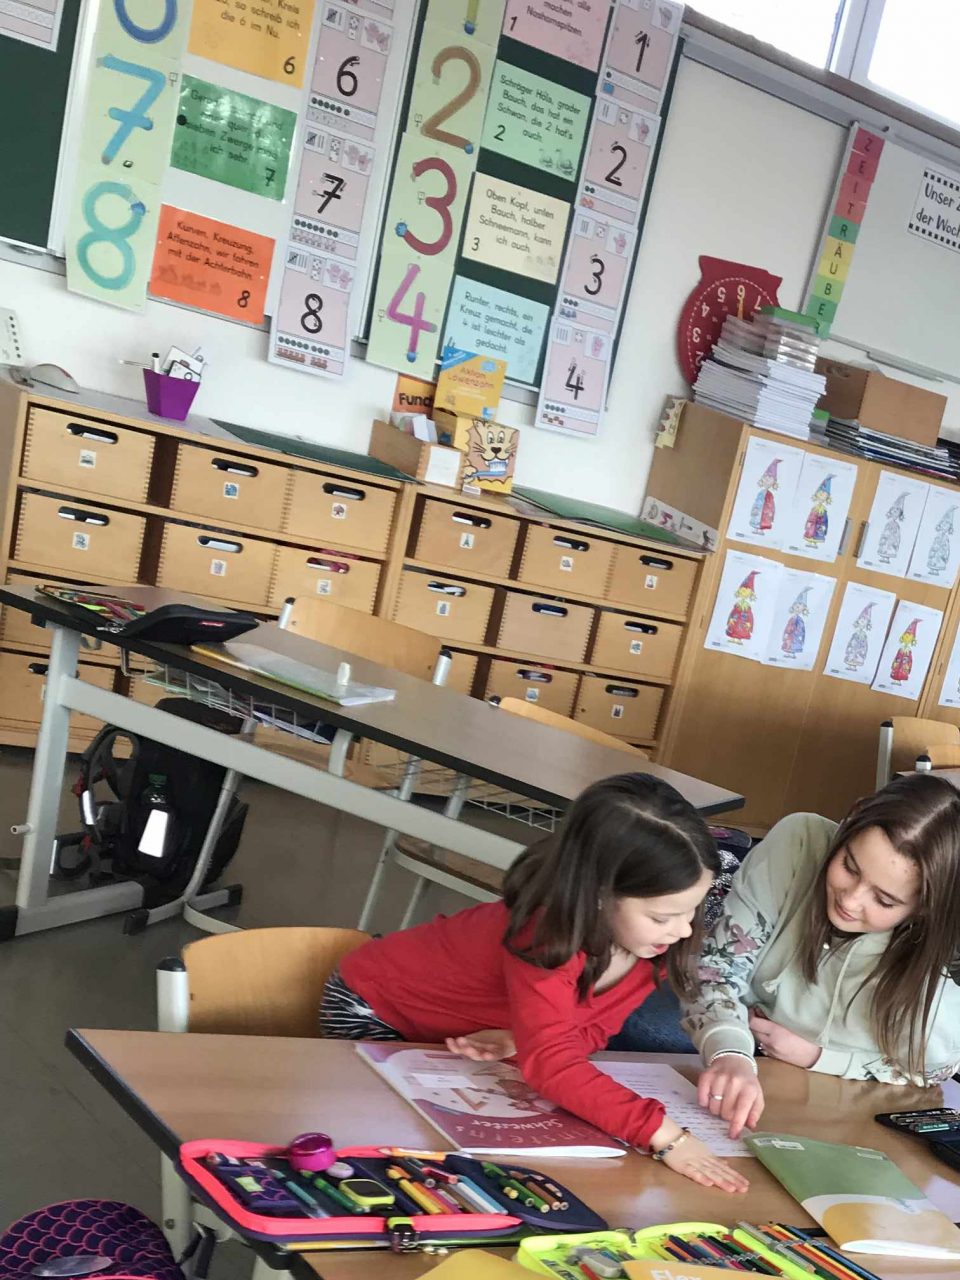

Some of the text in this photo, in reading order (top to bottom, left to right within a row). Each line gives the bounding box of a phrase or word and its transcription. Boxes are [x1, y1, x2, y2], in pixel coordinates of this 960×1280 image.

[510, 16, 518, 31] 1
[634, 31, 651, 73] 1
[283, 56, 296, 75] 6
[336, 56, 360, 96] 6
[97, 53, 166, 165] 7
[420, 46, 482, 154] 2
[493, 124, 506, 142] 2
[545, 122, 552, 131] 2
[604, 140, 629, 187] 2
[266, 167, 276, 187] 7
[317, 173, 347, 214] 7
[486, 188, 507, 203] Oben
[924, 182, 955, 208] Unser
[396, 157, 457, 256] 3
[916, 207, 934, 226] der
[76, 180, 147, 291] 8
[471, 236, 480, 252] 3
[584, 254, 606, 296] 3
[237, 290, 250, 308] 8
[717, 286, 727, 303] 5
[754, 295, 762, 310] 7
[300, 292, 323, 334] 8
[385, 263, 438, 363] 4
[701, 302, 710, 318] 4
[692, 327, 702, 343] 3
[564, 358, 585, 401] 4
